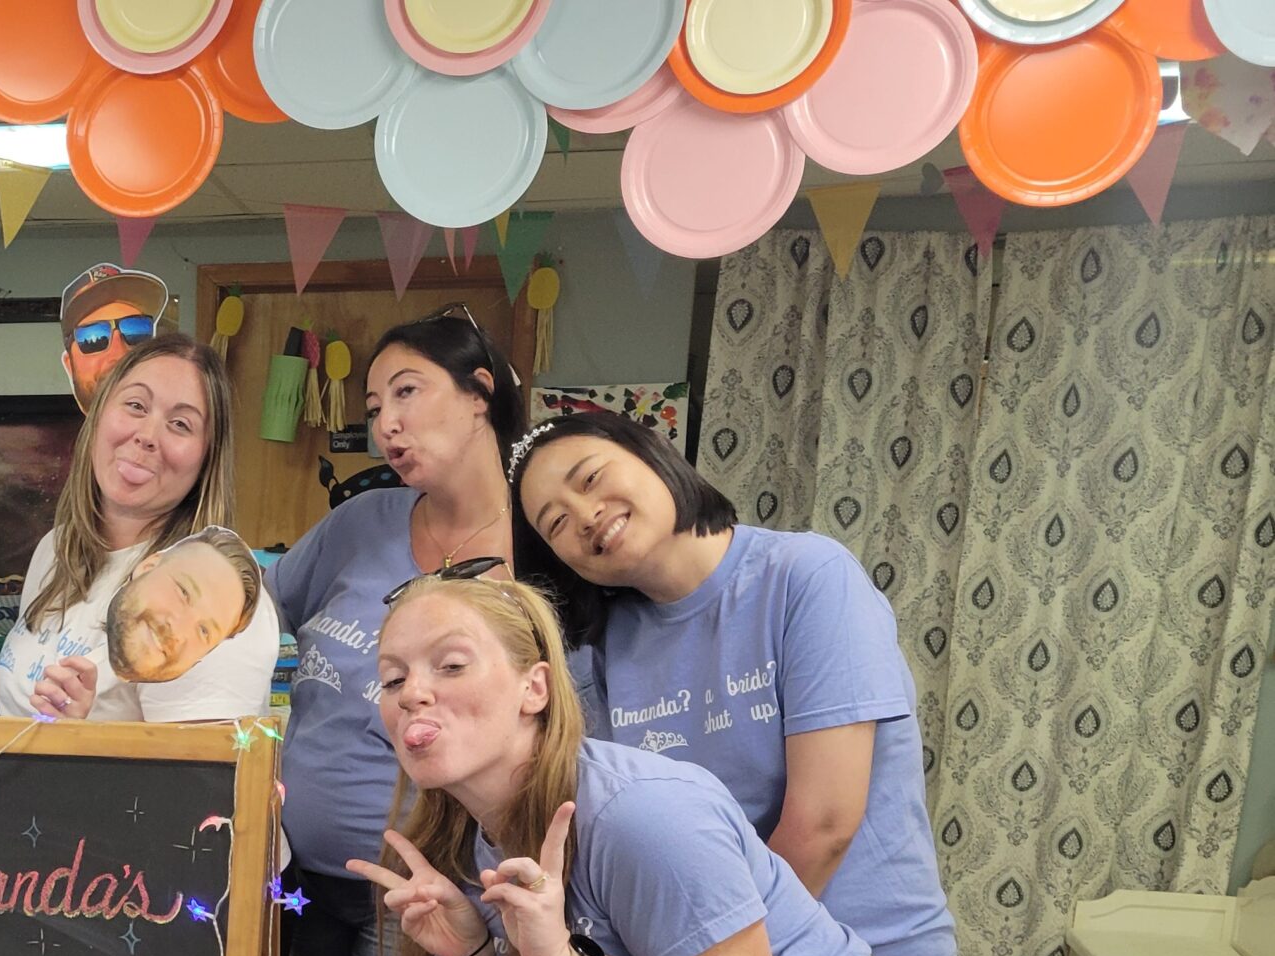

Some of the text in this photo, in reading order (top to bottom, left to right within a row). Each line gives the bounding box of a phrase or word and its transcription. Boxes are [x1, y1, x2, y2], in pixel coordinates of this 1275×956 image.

[333, 441, 350, 449] Only
[611, 660, 777, 728] Amanda? a bride?
[704, 702, 778, 735] shut up
